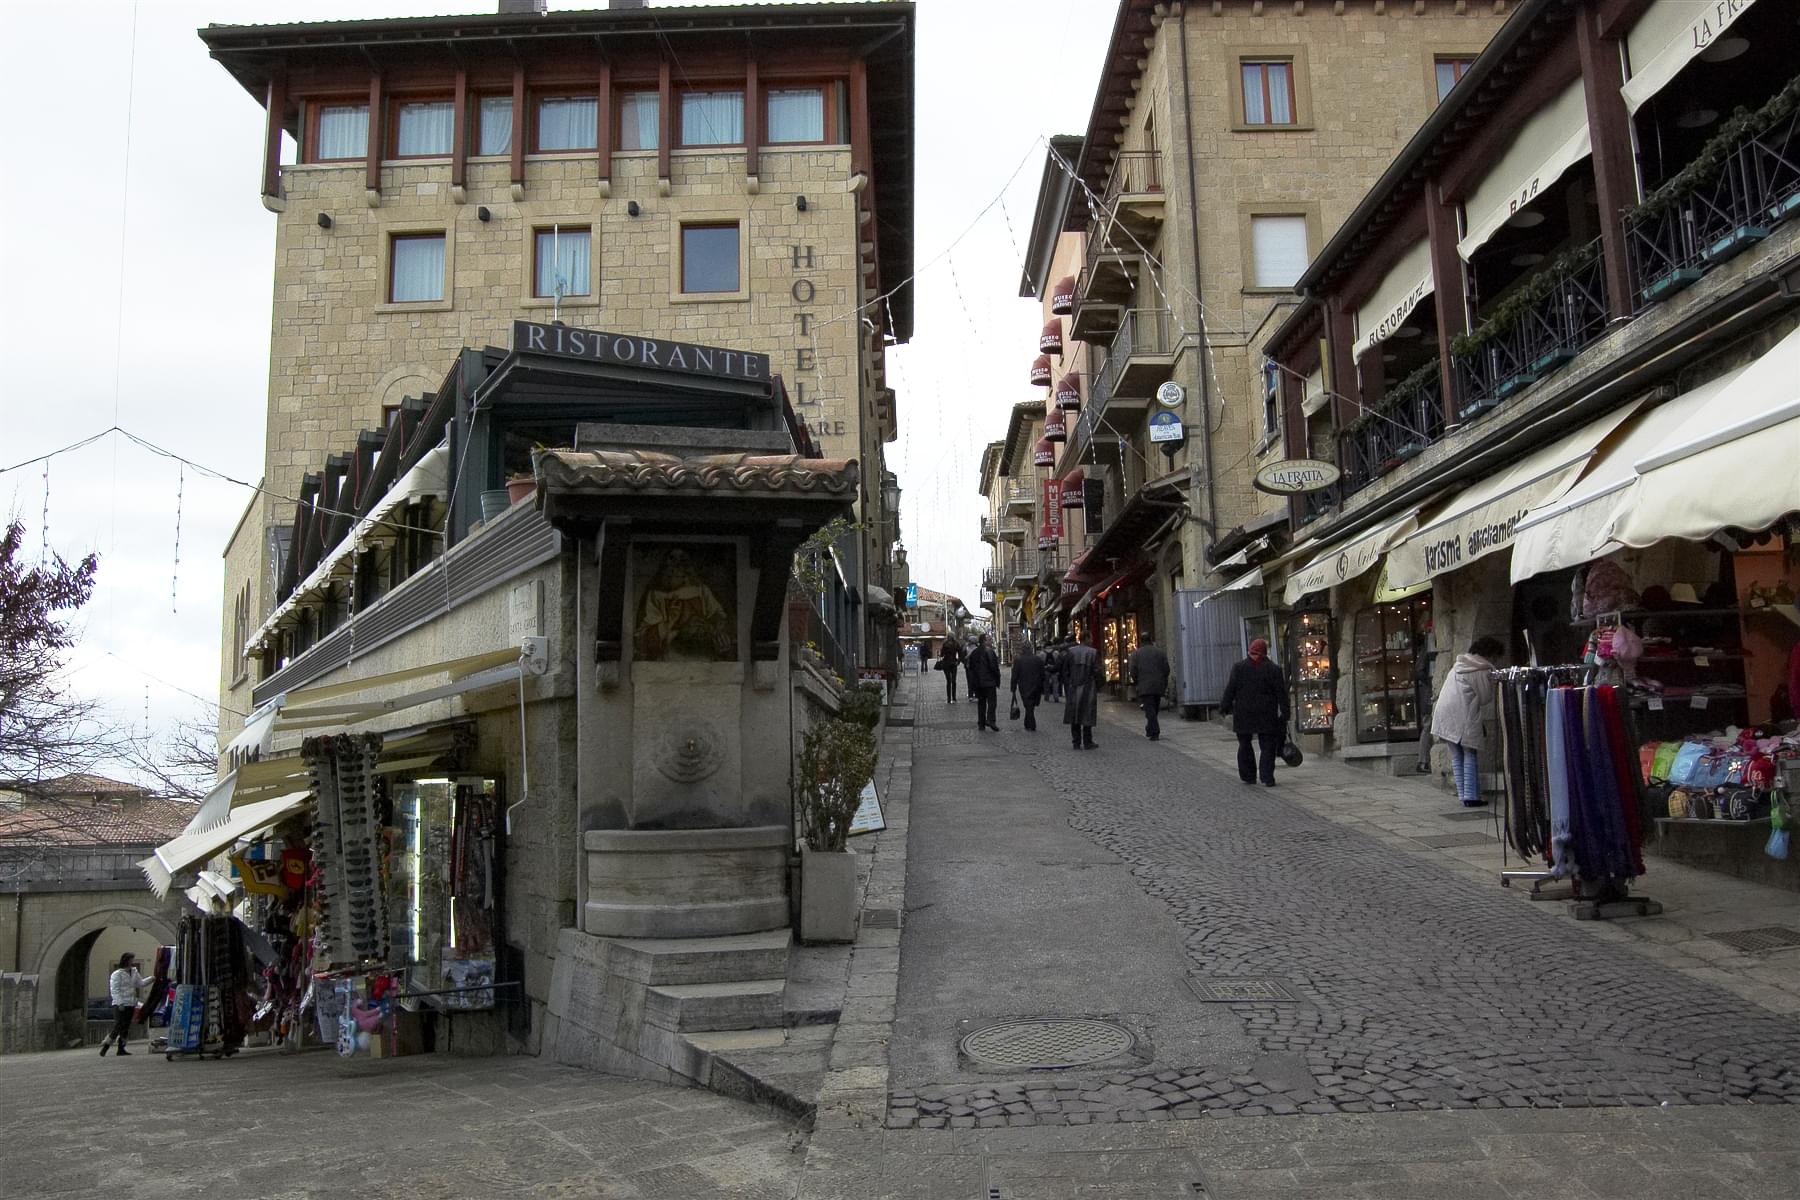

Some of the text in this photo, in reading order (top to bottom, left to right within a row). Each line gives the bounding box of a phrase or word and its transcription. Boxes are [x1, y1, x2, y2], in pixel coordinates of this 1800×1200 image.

[1692, 18, 1712, 49] LA
[1508, 178, 1540, 216] BAR
[791, 245, 816, 405] HOTEL
[1368, 281, 1425, 346] RISTORANTE
[527, 324, 760, 378] RISTORANTE
[1273, 470, 1324, 484] LA FRATTA
[1048, 485, 1059, 525] MUSEO
